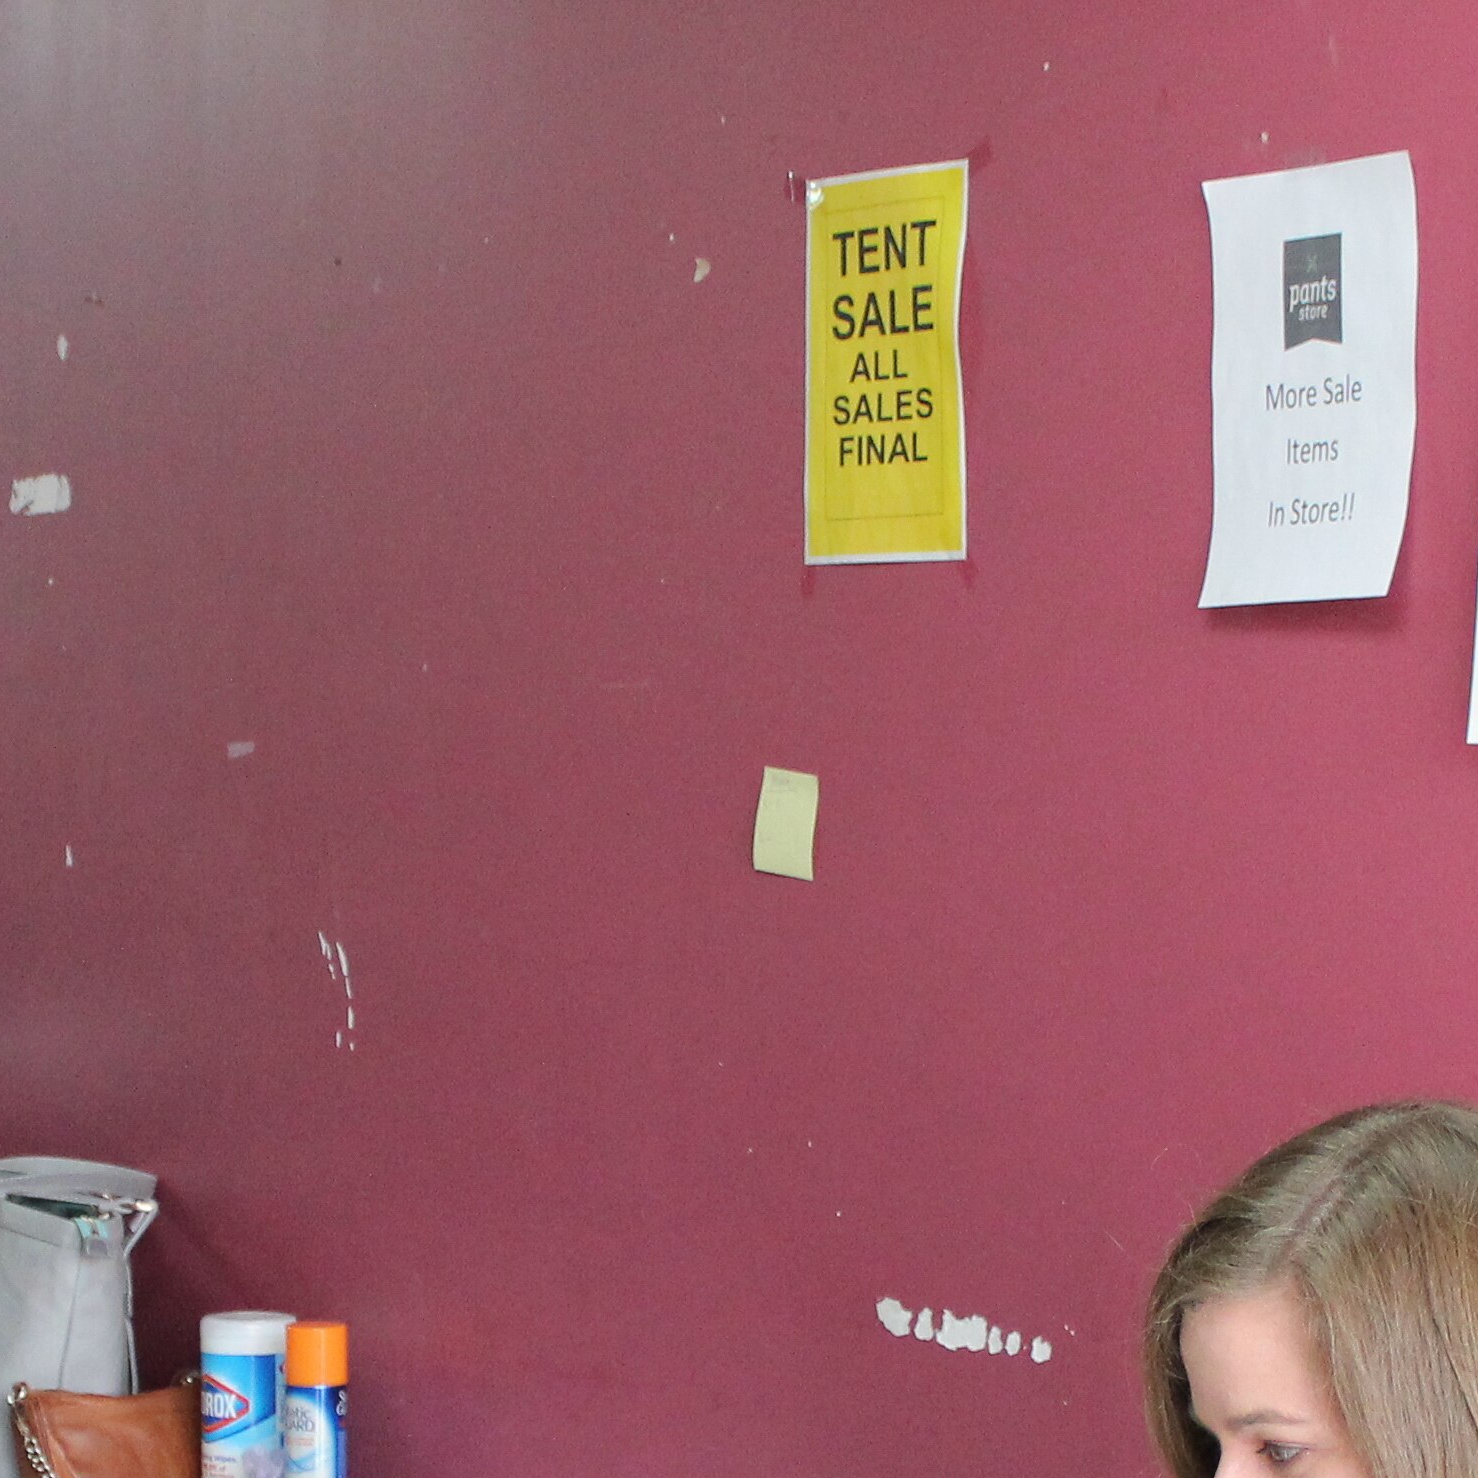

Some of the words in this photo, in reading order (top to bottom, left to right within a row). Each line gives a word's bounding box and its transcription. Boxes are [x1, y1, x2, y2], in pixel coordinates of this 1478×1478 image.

[832, 220, 938, 277] TENT
[1288, 275, 1338, 313] pants
[832, 285, 935, 341] SALE
[1298, 303, 1328, 323] store
[849, 350, 910, 384] ALL
[832, 387, 935, 428] SALES
[1265, 382, 1316, 411] More
[1322, 376, 1363, 405] Sale
[838, 432, 929, 467] FINAL
[1285, 435, 1339, 465] Items
[1267, 501, 1286, 528] In
[1289, 492, 1355, 525] Store!!
